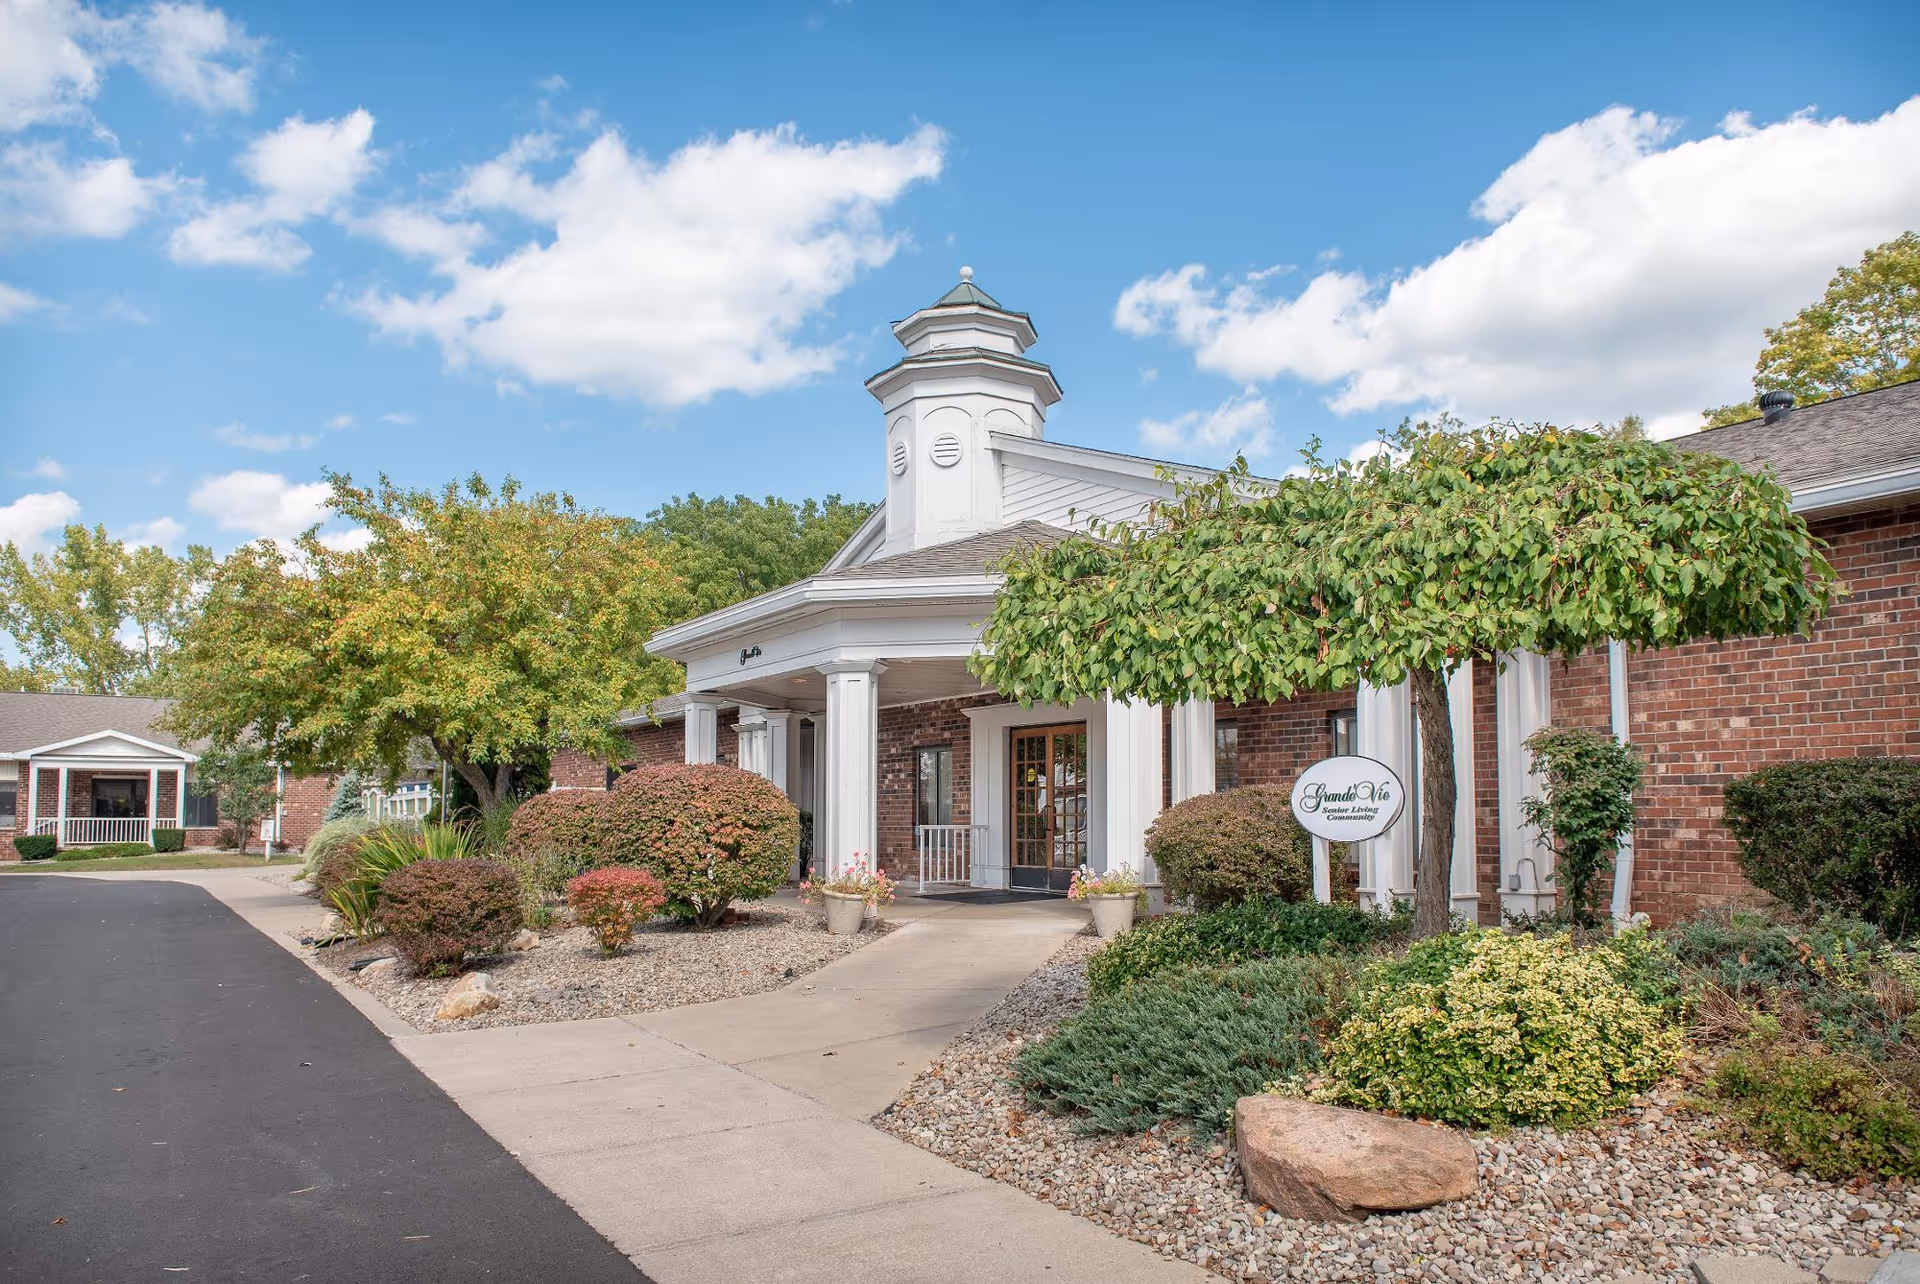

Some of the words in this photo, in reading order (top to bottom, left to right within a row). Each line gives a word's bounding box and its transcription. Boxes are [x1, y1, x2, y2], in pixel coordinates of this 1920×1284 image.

[1356, 781, 1390, 804] Vie
[1351, 806, 1379, 814] Living
[1326, 814, 1375, 822] Community
